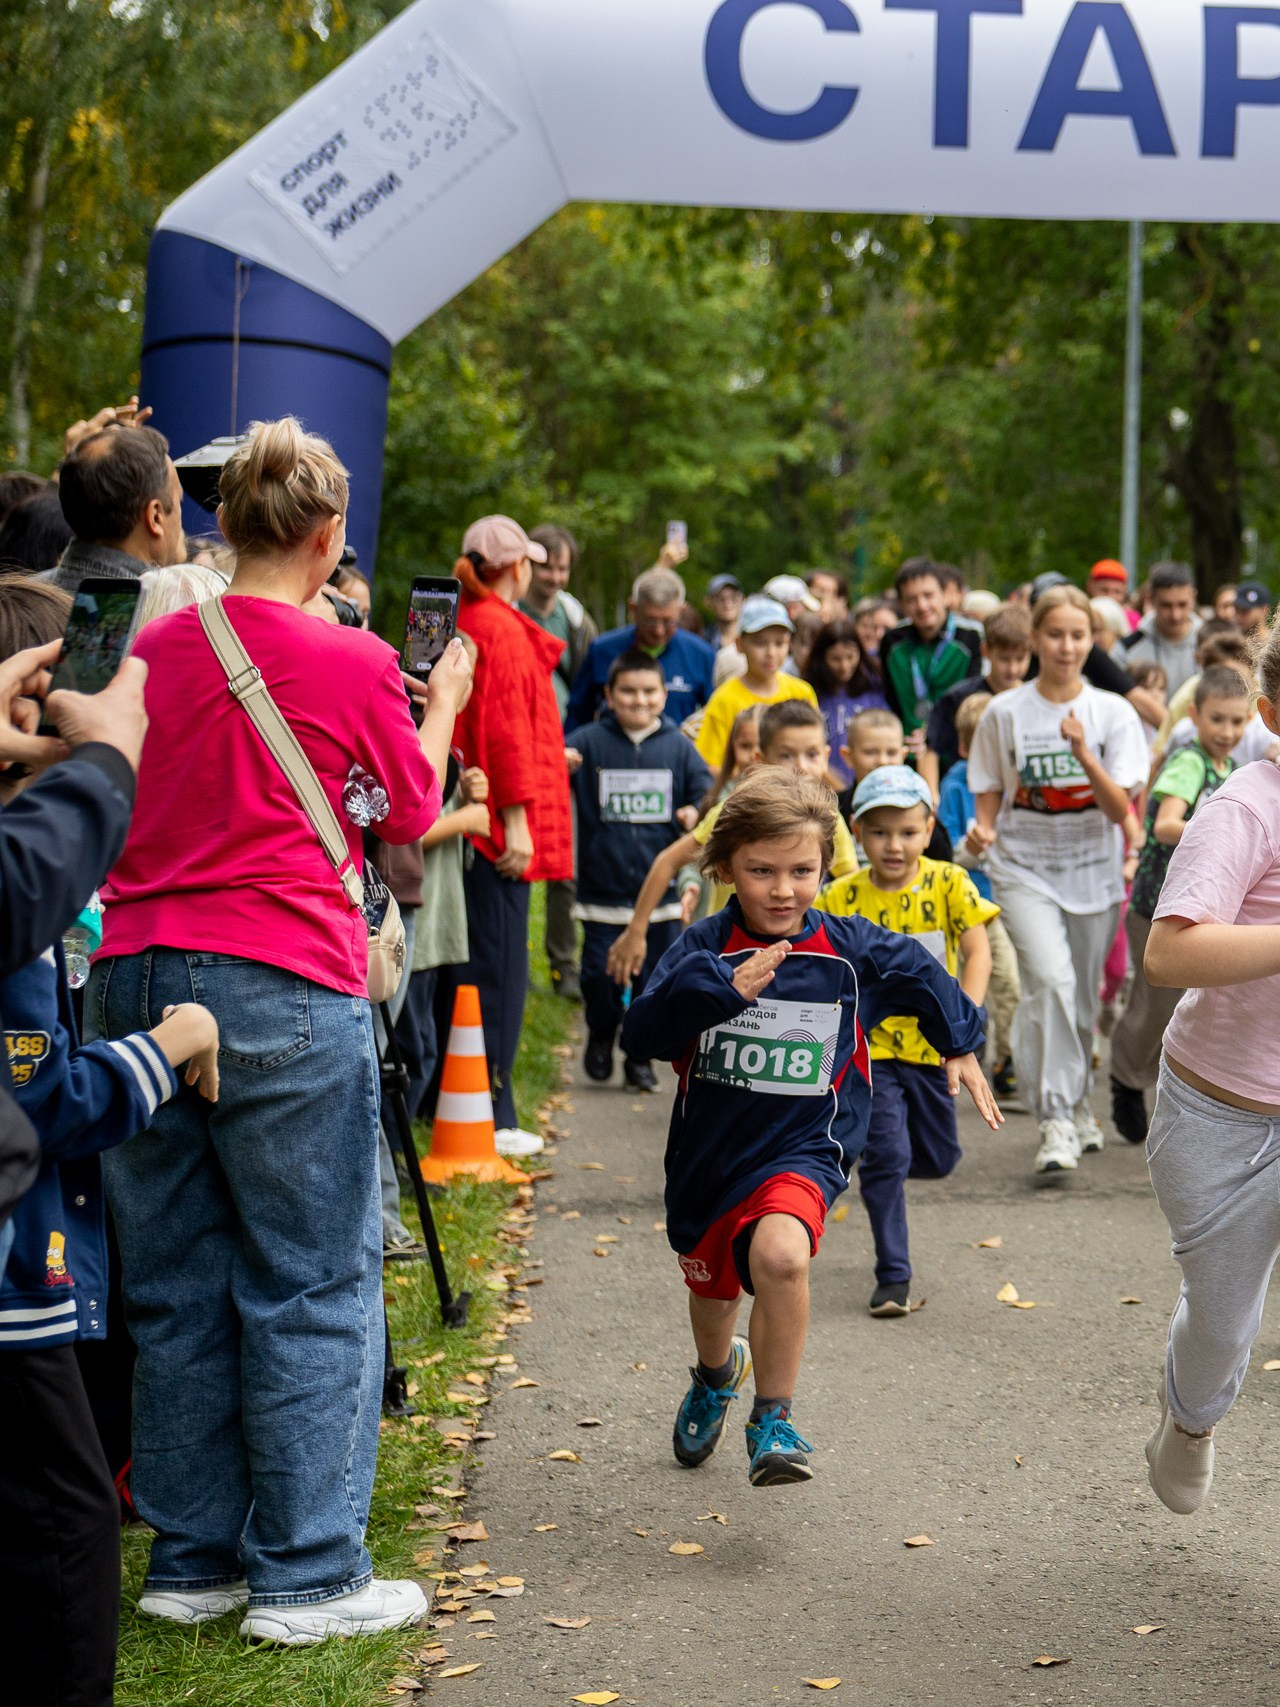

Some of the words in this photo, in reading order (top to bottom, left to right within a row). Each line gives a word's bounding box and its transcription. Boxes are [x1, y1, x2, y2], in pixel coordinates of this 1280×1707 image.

[280, 129, 349, 193] спорт
[301, 170, 349, 220] для
[322, 171, 403, 240] жизни
[611, 794, 660, 814] 1104
[722, 1019, 761, 1030] АЗАНЬ
[741, 1008, 777, 1019] родов
[720, 1040, 814, 1079] 1018
